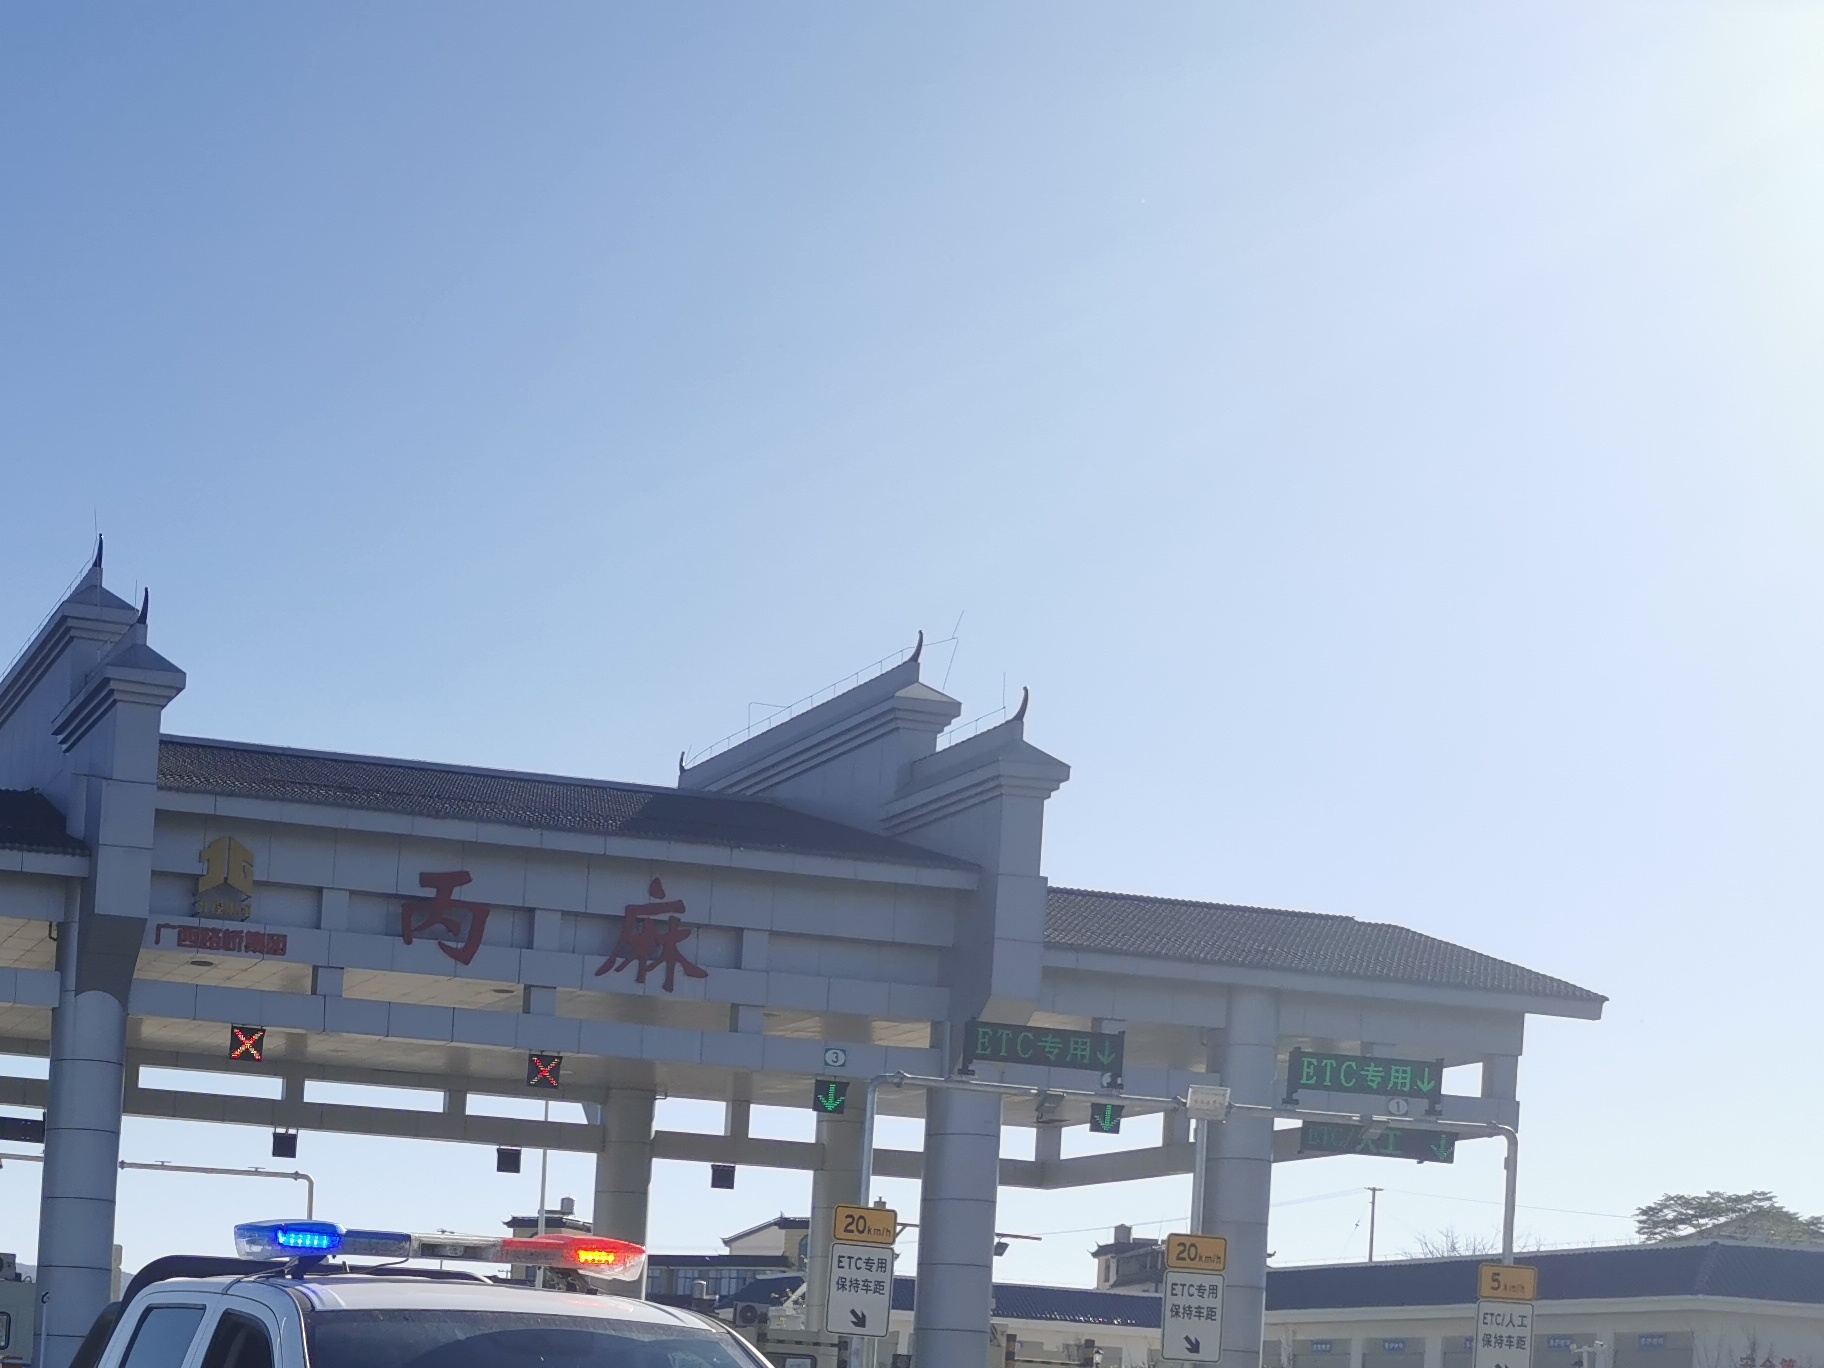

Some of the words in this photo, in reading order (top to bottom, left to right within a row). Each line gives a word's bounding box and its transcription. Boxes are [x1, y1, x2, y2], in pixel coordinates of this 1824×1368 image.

[976, 1027, 1091, 1064] ETC专用
[831, 1051, 839, 1064] 3
[1300, 1057, 1413, 1092] ETC专用
[837, 1254, 888, 1274] ETC专用
[836, 1276, 886, 1296] 保持车距
[1170, 1282, 1219, 1300] ETC专用
[1169, 1303, 1218, 1322] 保持车距
[1482, 1311, 1528, 1328] ETC/人工
[1481, 1333, 1527, 1351] 保持车距
